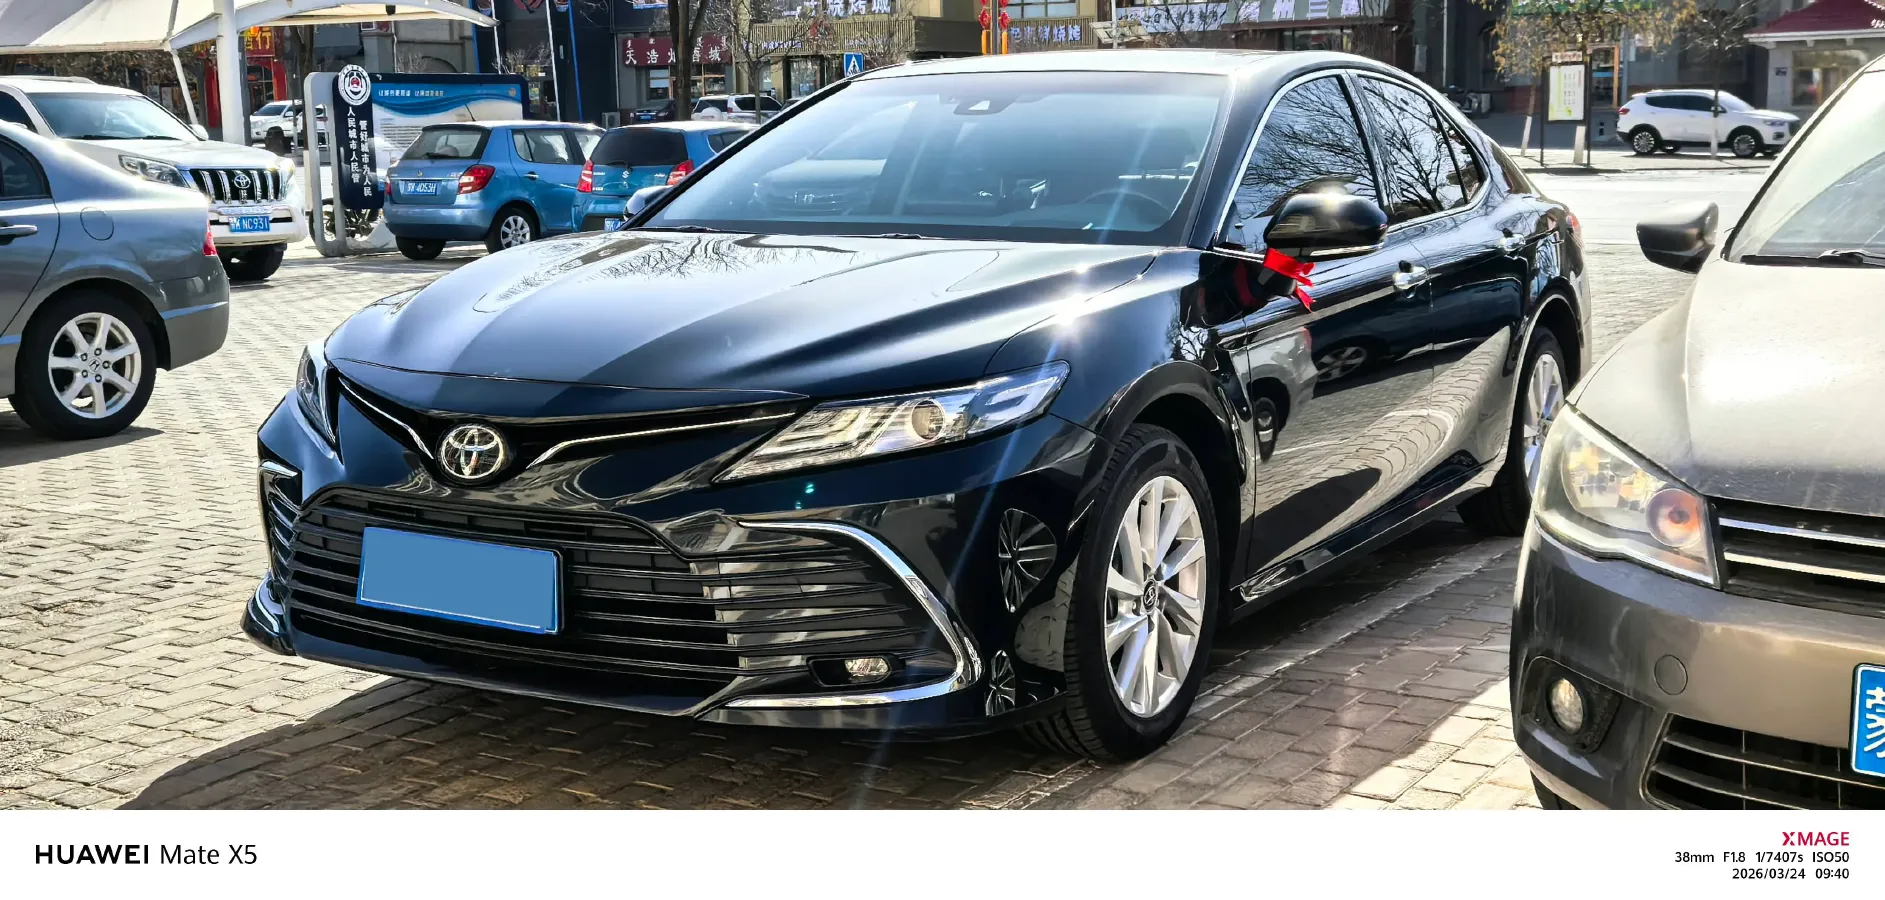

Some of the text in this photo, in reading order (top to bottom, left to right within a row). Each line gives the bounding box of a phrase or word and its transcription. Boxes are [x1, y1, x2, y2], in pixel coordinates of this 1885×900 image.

[347, 107, 360, 183] 人民城市人民管
[359, 121, 372, 196] 管好城市为人民
